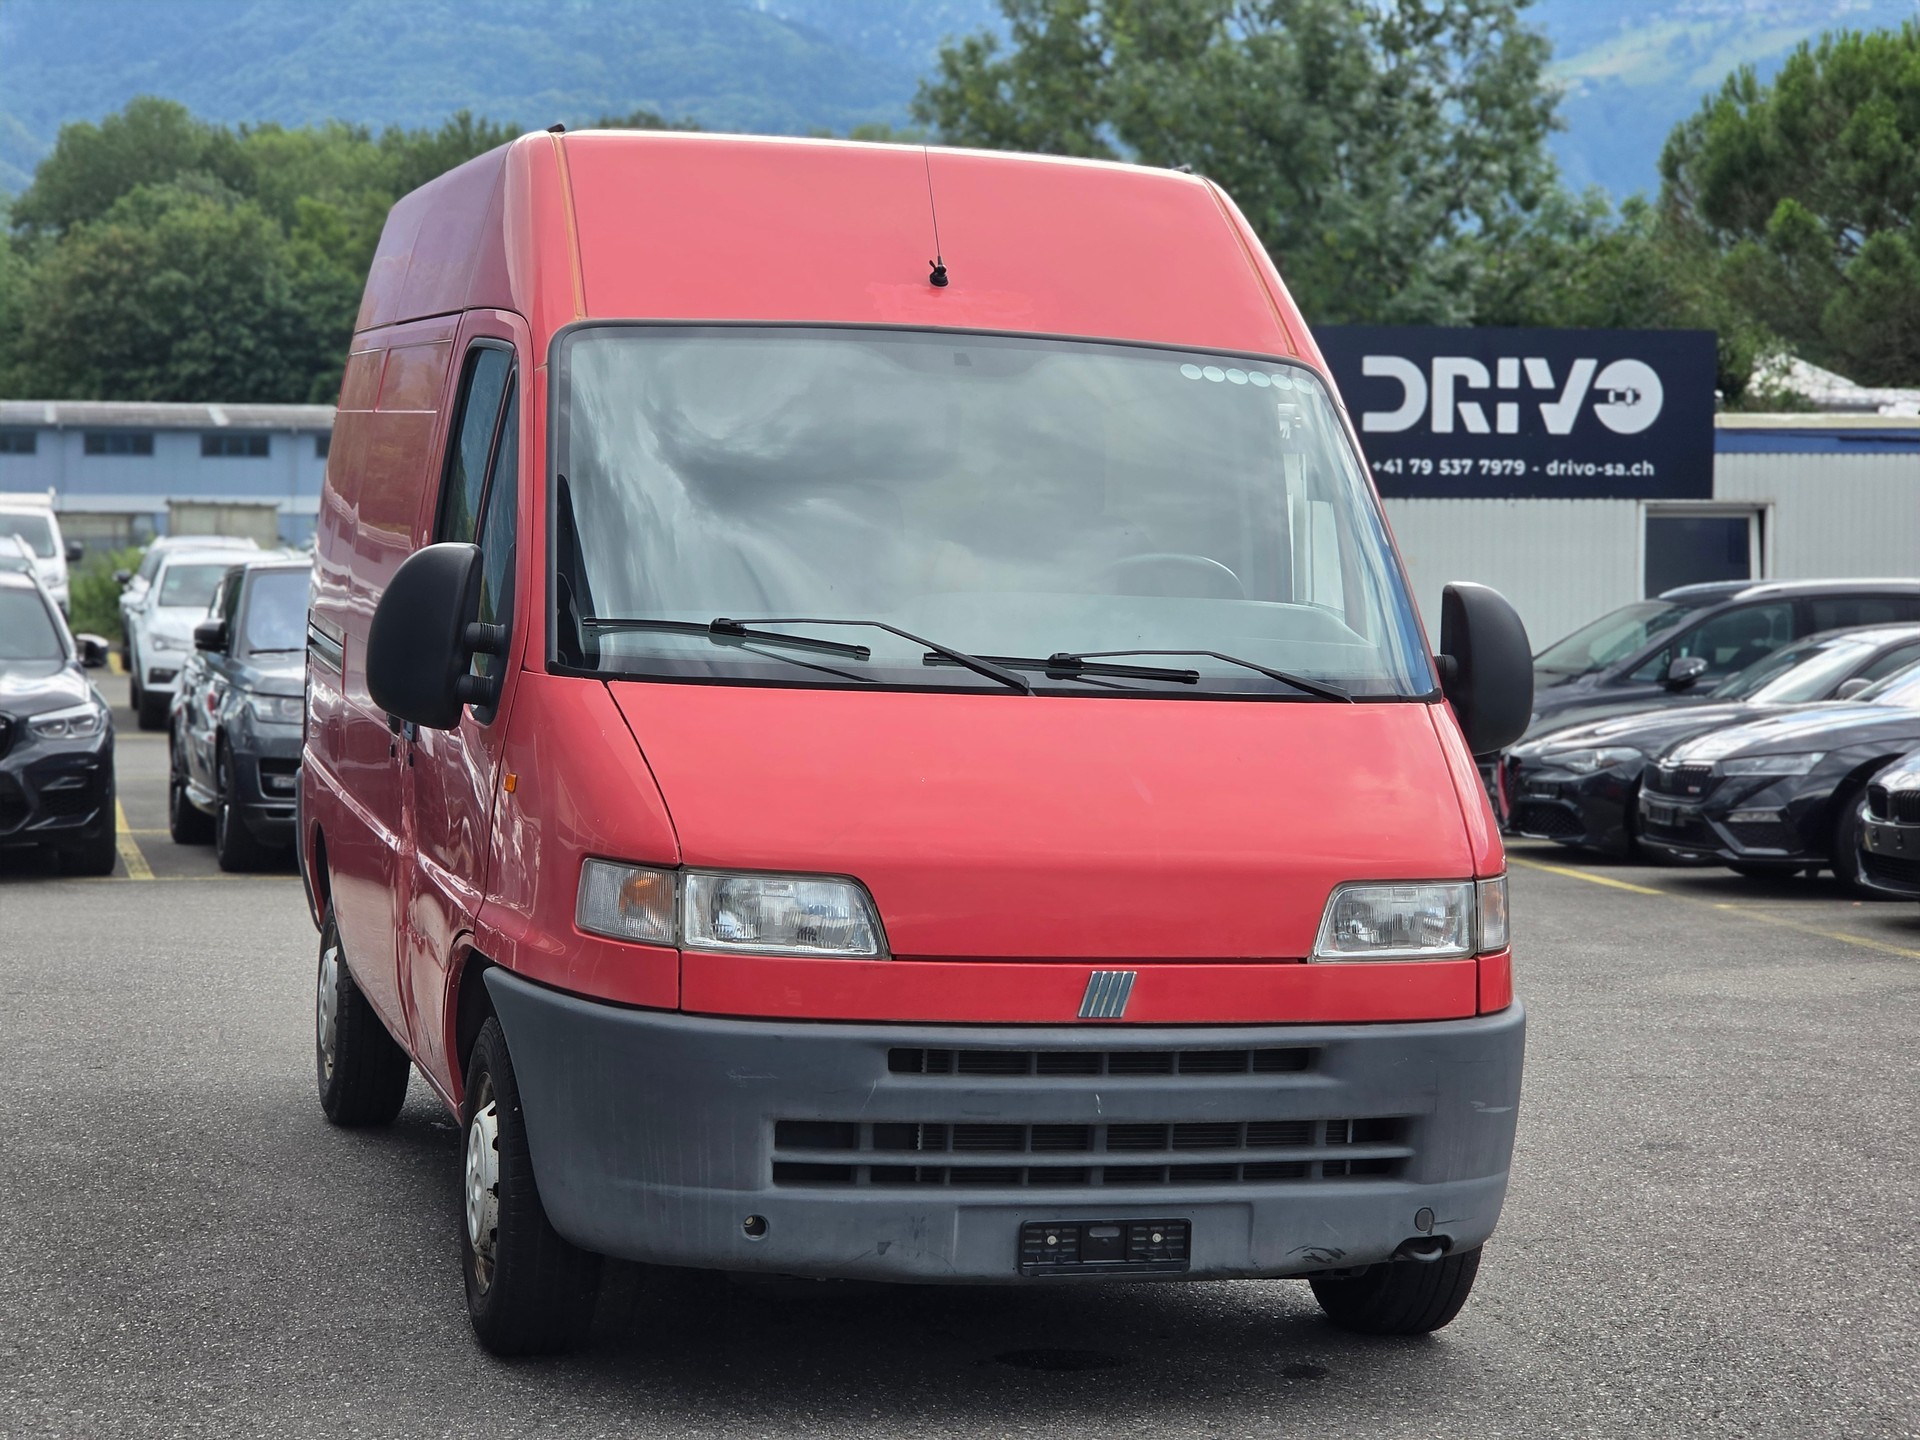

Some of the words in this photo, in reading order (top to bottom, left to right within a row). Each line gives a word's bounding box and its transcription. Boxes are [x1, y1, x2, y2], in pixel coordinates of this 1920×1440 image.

[1362, 355, 1664, 435] DRIVO
[1372, 458, 1403, 474] +41
[1409, 458, 1433, 476] 79
[1439, 458, 1473, 476] 537
[1479, 458, 1526, 476] 7979
[1546, 459, 1655, 477] drivo-sa.ch
